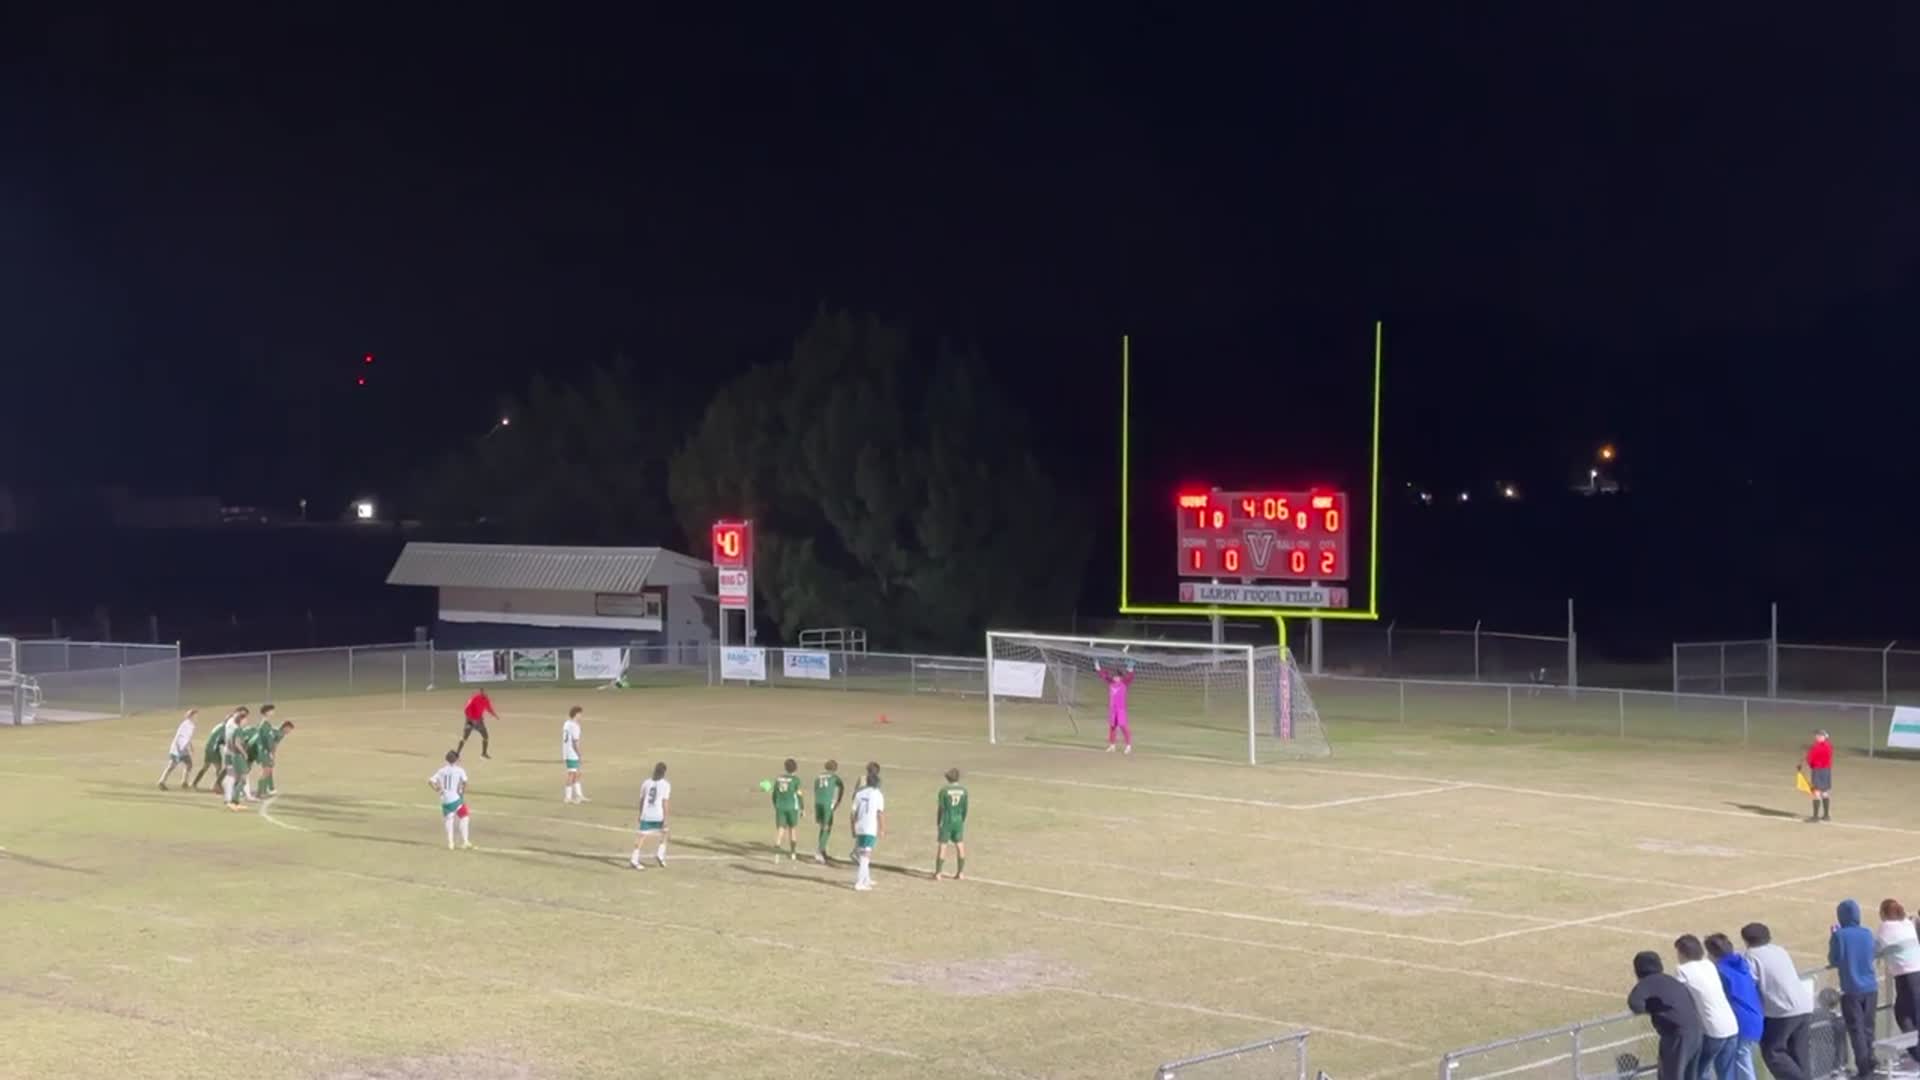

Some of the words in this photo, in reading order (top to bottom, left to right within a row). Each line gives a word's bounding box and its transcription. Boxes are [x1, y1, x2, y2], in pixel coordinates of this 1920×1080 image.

[1242, 498, 1290, 520] 4:06
[1325, 510, 1339, 532] 0
[717, 531, 739, 557] 40
[1246, 532, 1274, 570] V
[1194, 551, 1201, 569] 1
[1225, 549, 1239, 572] 0
[1291, 551, 1305, 573] 0
[1321, 551, 1335, 573] 2
[1200, 587, 1239, 601] LARRY
[1244, 589, 1281, 602] FUQUA
[1285, 591, 1323, 604] FIELD
